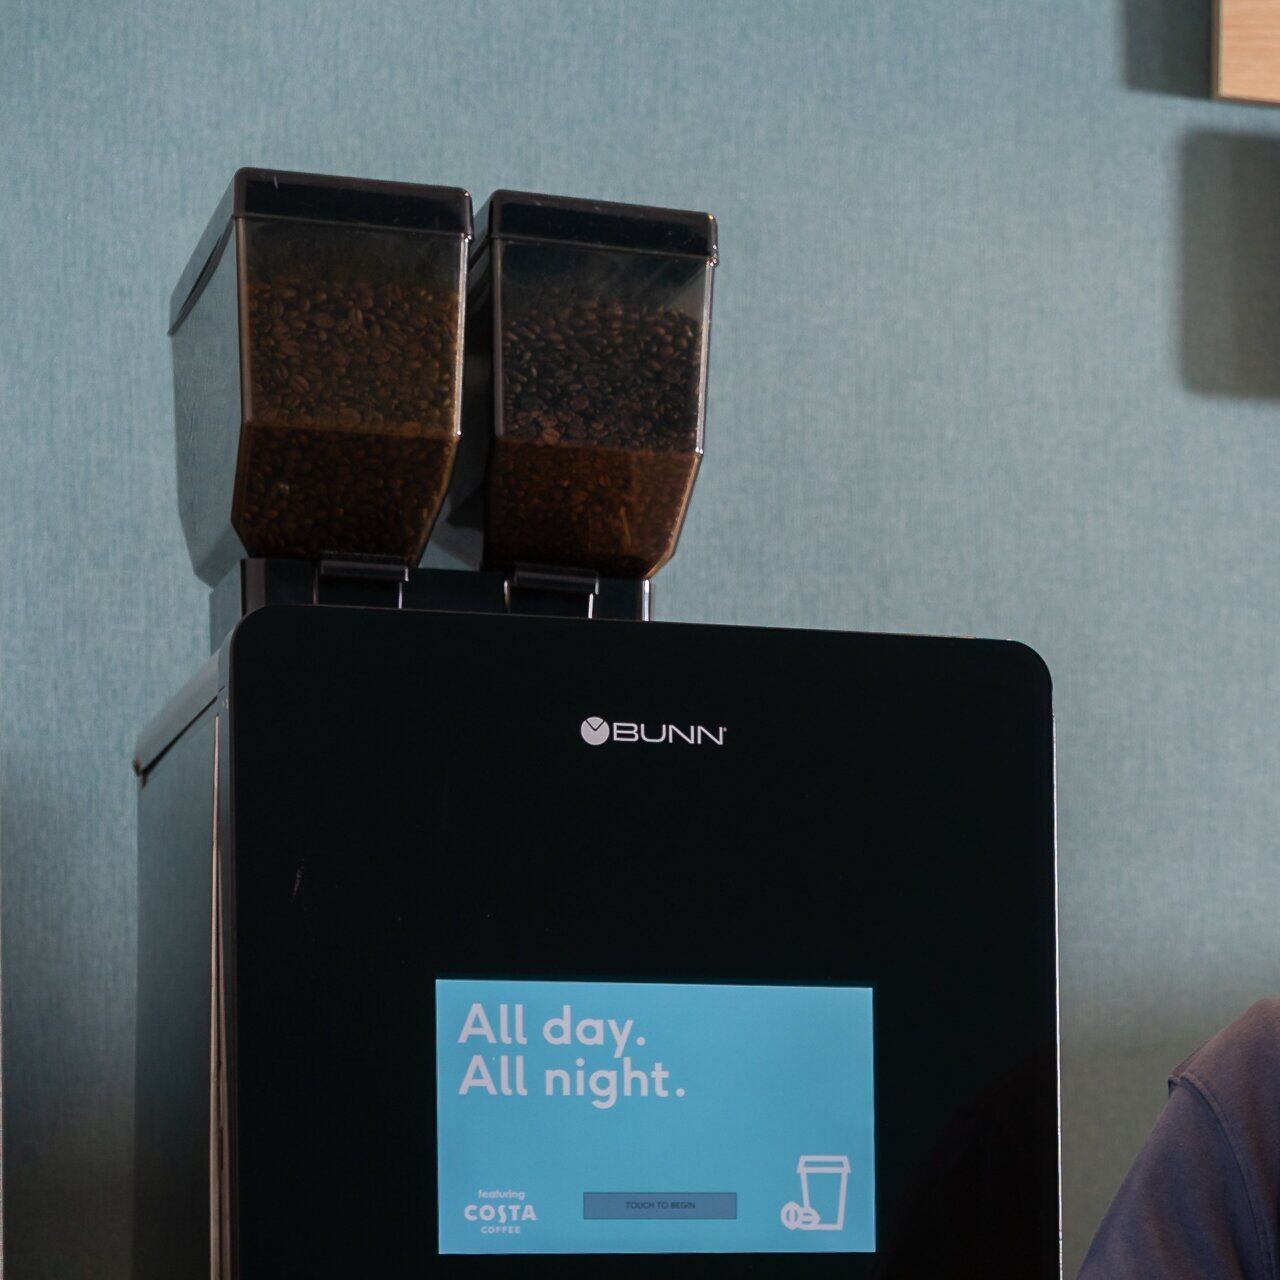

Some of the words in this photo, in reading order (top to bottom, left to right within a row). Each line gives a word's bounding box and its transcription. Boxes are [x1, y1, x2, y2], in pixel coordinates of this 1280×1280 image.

[612, 721, 725, 746] BUNN
[457, 1002, 528, 1045] All
[542, 1004, 647, 1059] day.
[458, 1054, 528, 1096] All
[545, 1056, 686, 1110] night.
[477, 1188, 526, 1201] featuring
[463, 1203, 538, 1223] COSTA
[625, 1200, 655, 1210] TOUCH
[657, 1200, 669, 1210] TO
[670, 1200, 696, 1210] BEGIN
[480, 1225, 521, 1235] COFFEE
